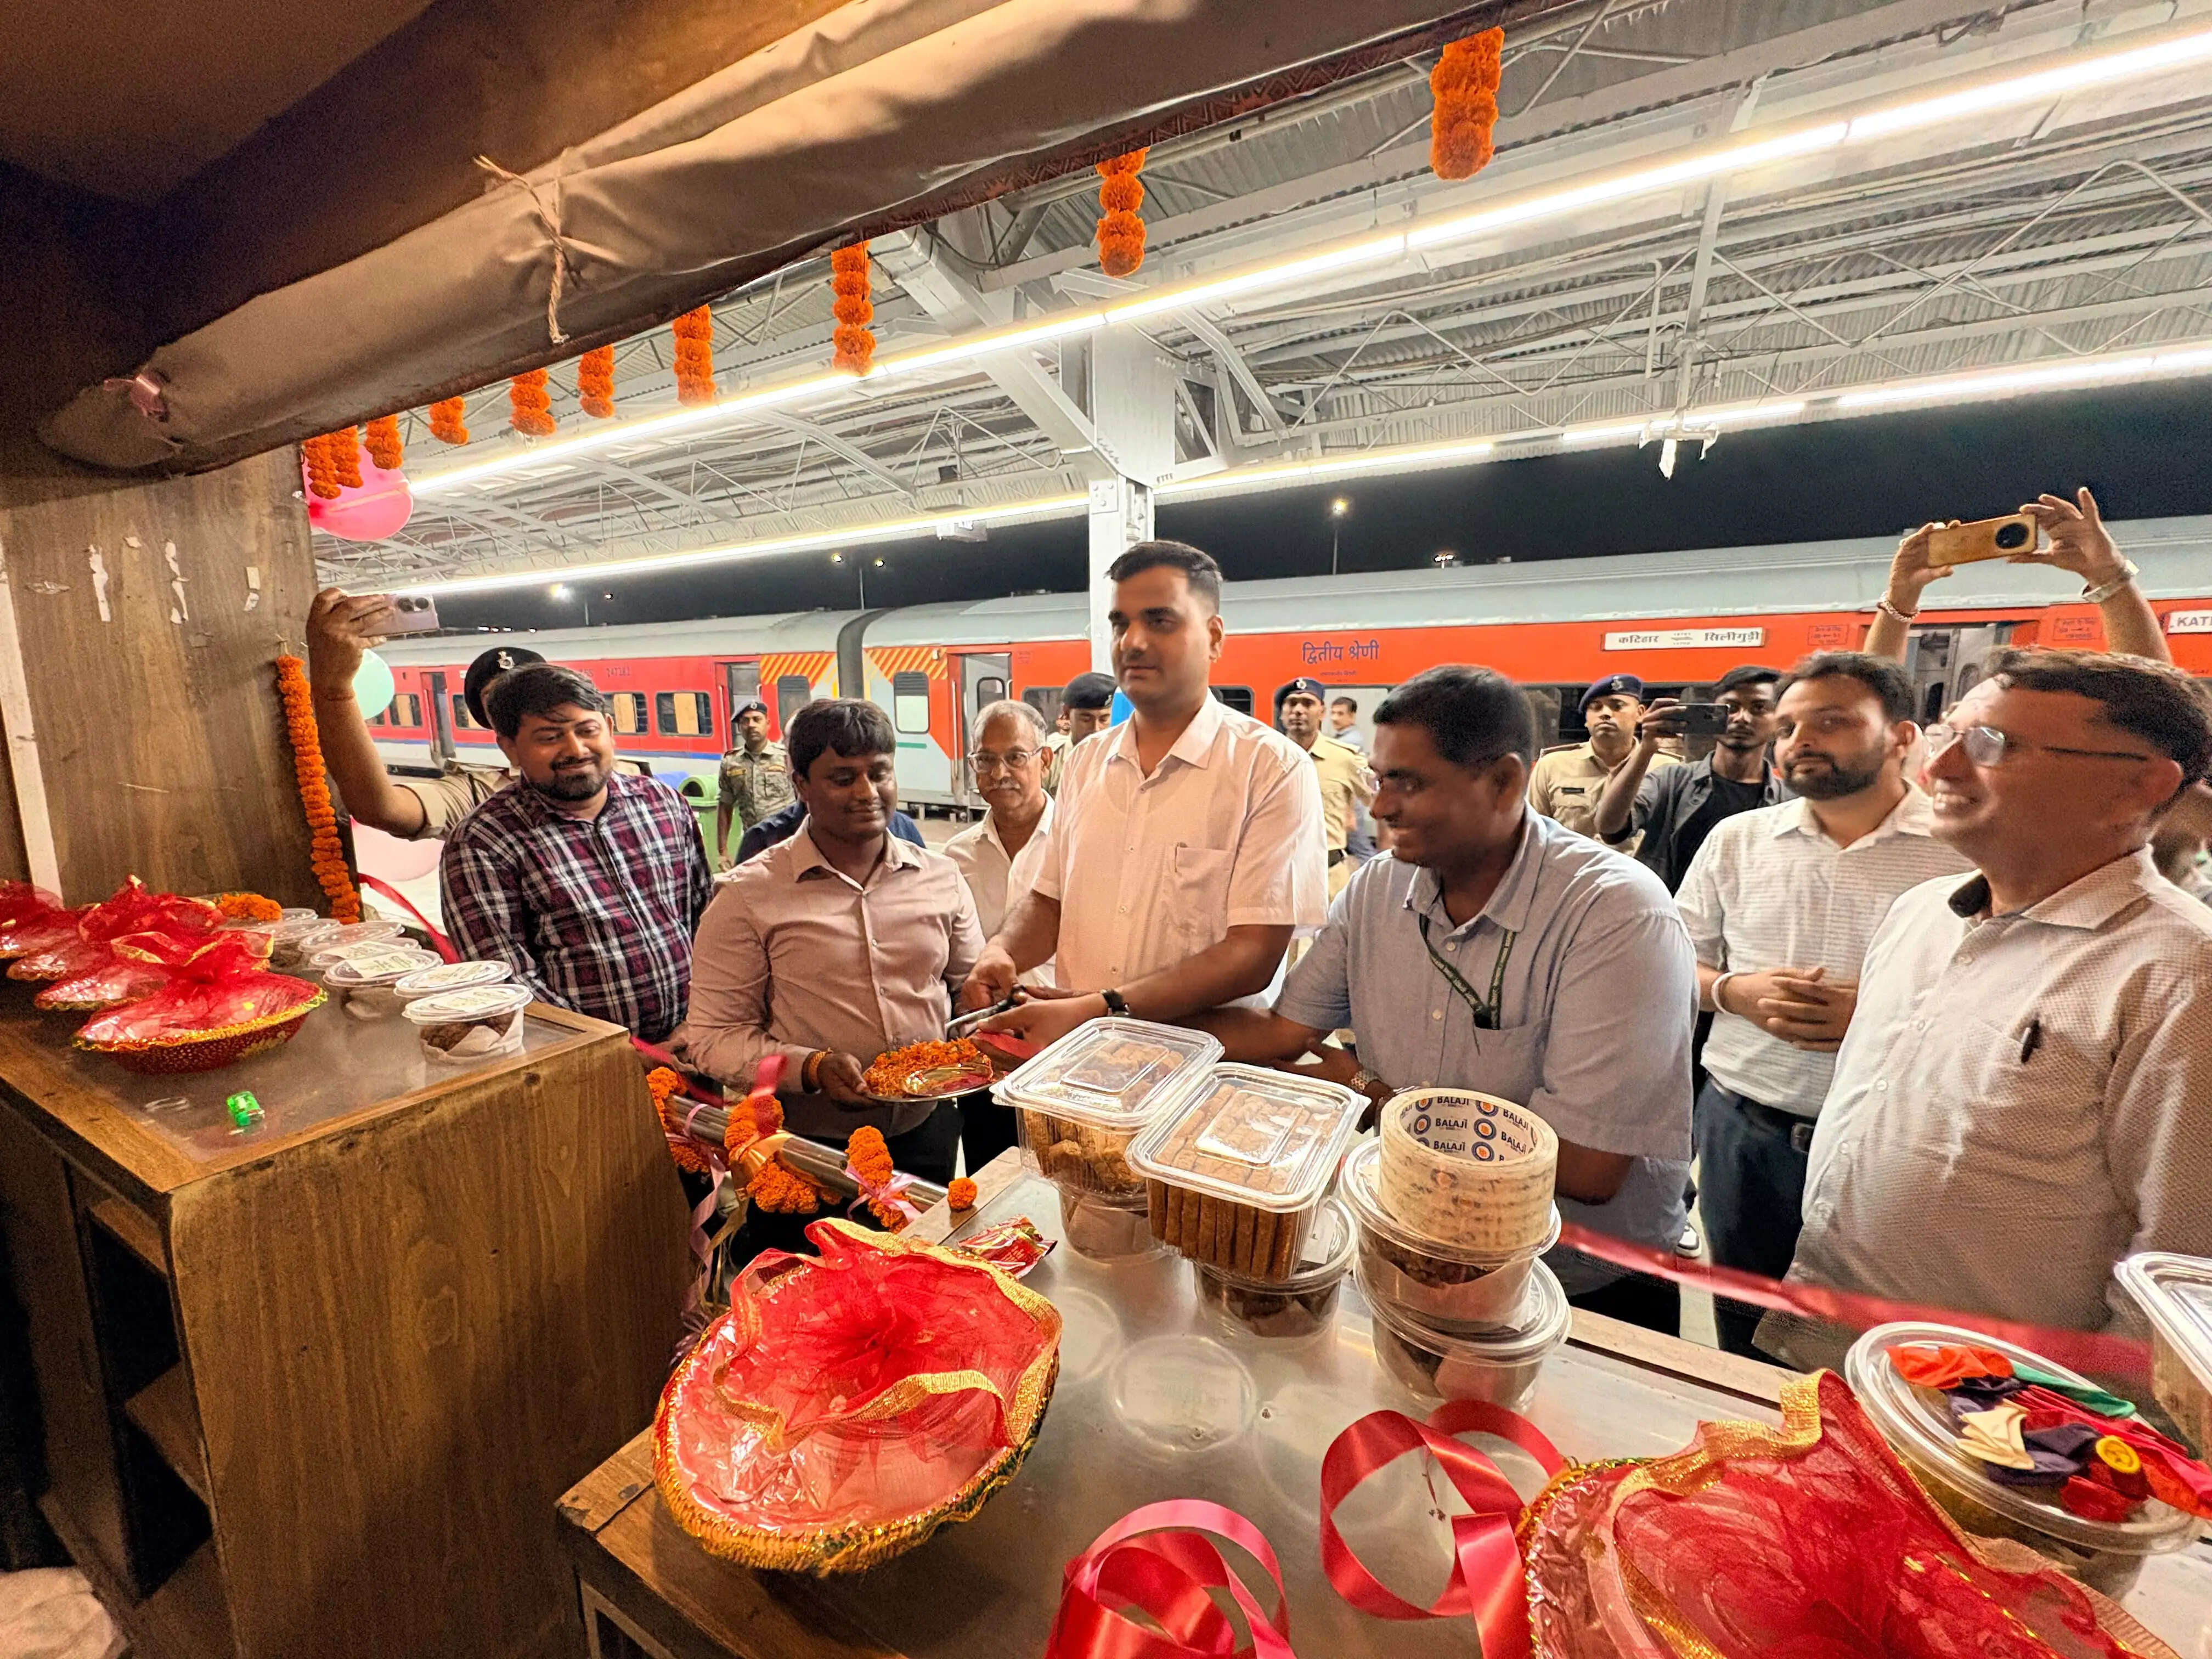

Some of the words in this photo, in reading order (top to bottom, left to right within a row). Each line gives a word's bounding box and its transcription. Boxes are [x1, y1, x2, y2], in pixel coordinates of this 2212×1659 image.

[1302, 641, 1344, 664] द्वितीय
[1349, 639, 1379, 660] श्रेणी
[1437, 1096, 1469, 1105] BALAJI
[1436, 1118, 1468, 1128] BALAJI
[1503, 1109, 1528, 1131] BALAJI
[1434, 1141, 1465, 1151] BALAJI
[1501, 1131, 1526, 1154] BALAJI
